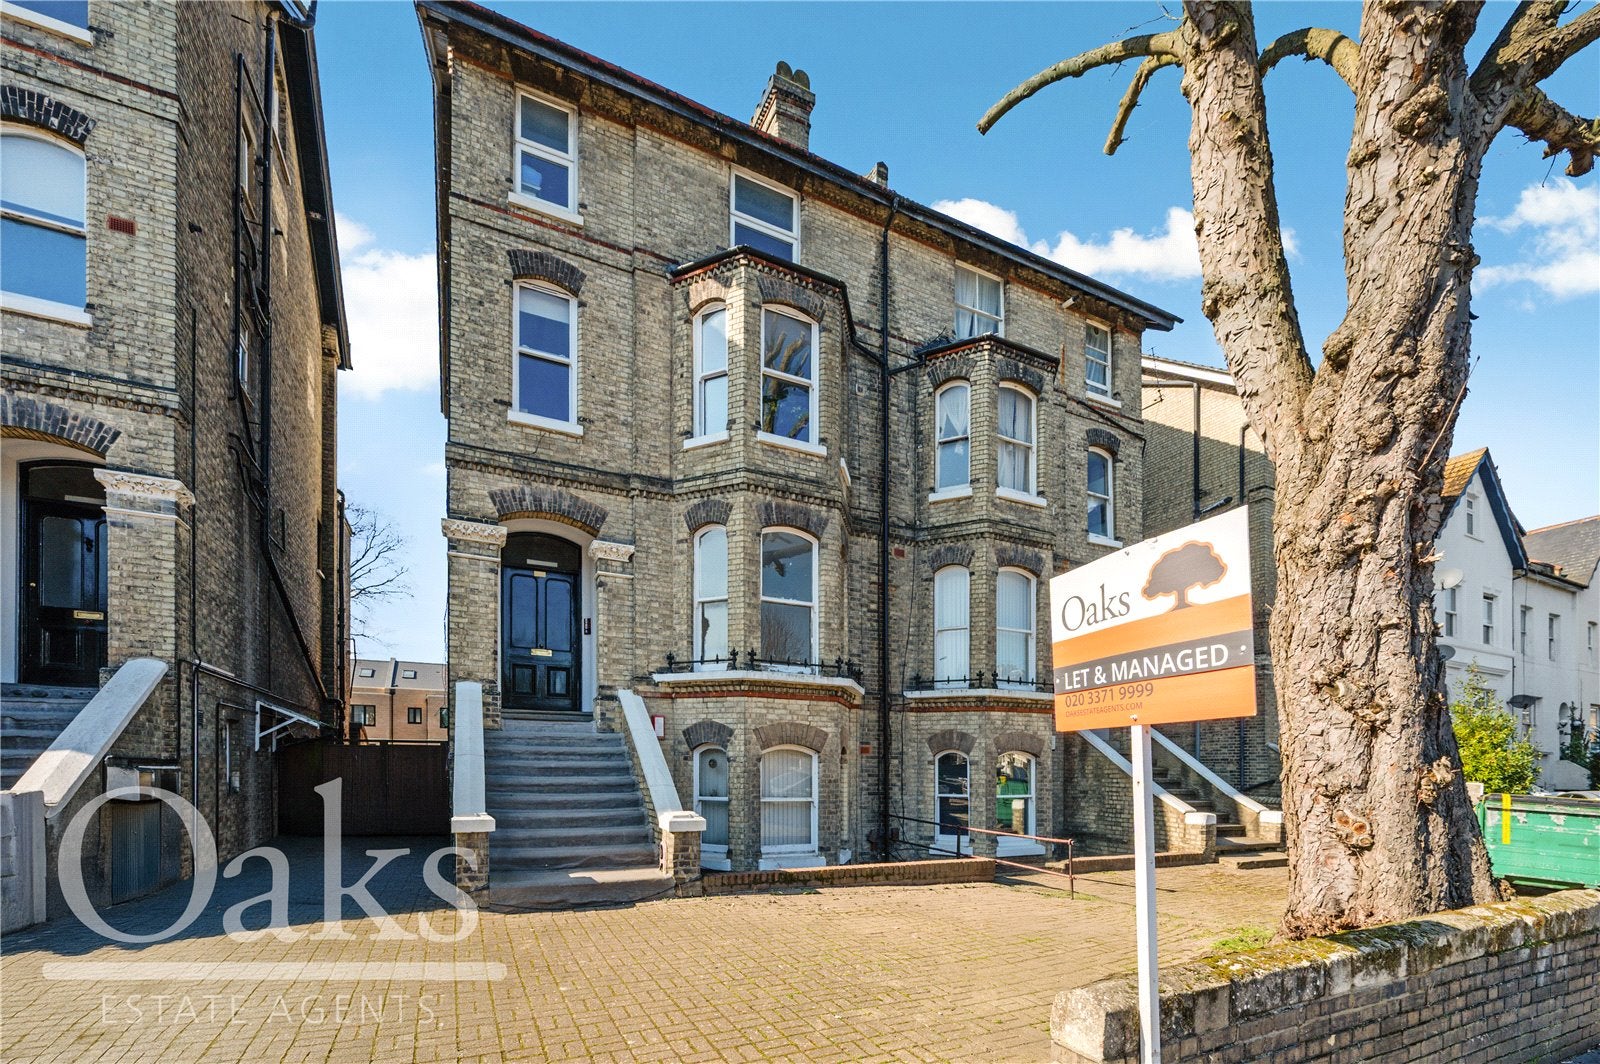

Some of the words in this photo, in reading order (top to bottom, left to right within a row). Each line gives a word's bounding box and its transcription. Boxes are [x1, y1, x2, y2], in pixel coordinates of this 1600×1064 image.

[1062, 583, 1131, 631] Oaks
[1065, 668, 1090, 690] LET
[1094, 666, 1107, 685] &
[1111, 644, 1229, 682] MANAGED
[1065, 693, 1084, 708] 020
[1088, 688, 1114, 705] 3371
[1119, 682, 1153, 701] 9999
[1065, 702, 1143, 718] OAKSESTATEAGENTS.COM
